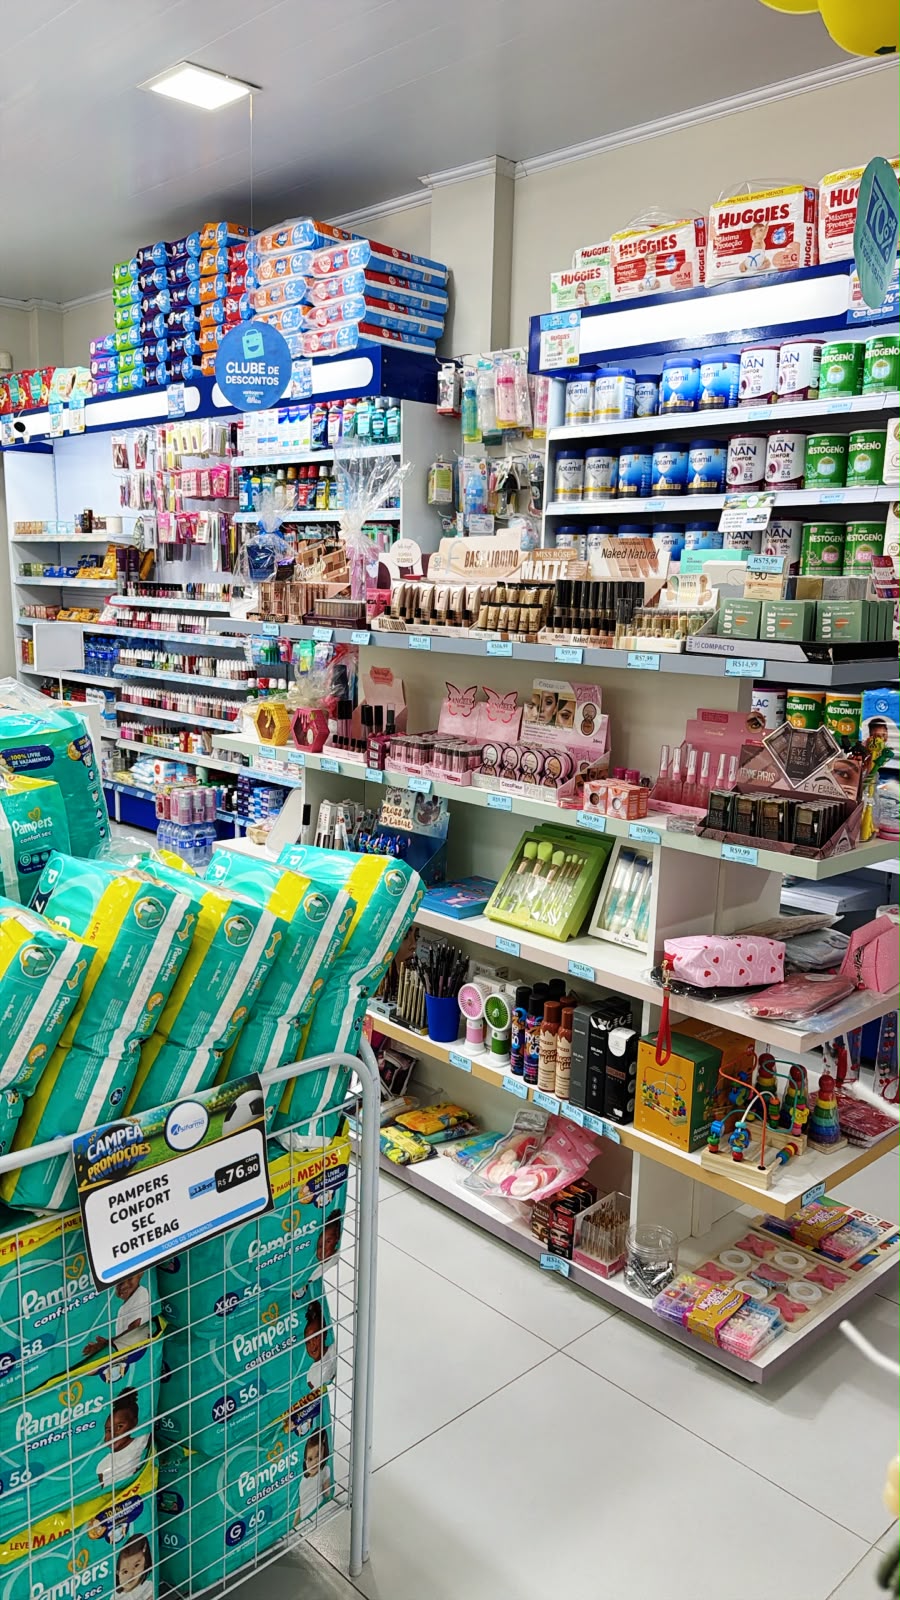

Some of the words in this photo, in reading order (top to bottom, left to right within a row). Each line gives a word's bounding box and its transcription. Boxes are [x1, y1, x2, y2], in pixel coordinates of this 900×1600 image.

[718, 203, 791, 230] HUGGIES
[294, 224, 304, 238] 62
[350, 248, 360, 259] 52
[619, 234, 678, 258] HUGGIES
[804, 226, 812, 266] HUGGIES
[292, 254, 302, 268] 62
[345, 276, 354, 288] 52
[561, 268, 602, 286] HUGGIES
[286, 282, 296, 294] 62
[283, 311, 293, 322] 62
[344, 302, 354, 313] 52
[340, 329, 349, 340] 52
[226, 362, 266, 374] CLUBE
[268, 366, 280, 375] DE
[226, 376, 279, 386] DESCONTOS
[730, 445, 756, 456] NAN
[768, 442, 795, 453] NAN
[654, 457, 677, 466] Aptamil
[765, 528, 792, 538] NAN
[601, 548, 627, 560] Naked
[628, 548, 660, 560] Natural
[521, 560, 568, 580] MATTE
[723, 608, 733, 634] LOVE
[766, 612, 776, 638] LOVE
[822, 612, 832, 638] LOVE
[573, 636, 588, 644] Naked
[701, 643, 735, 652] COMPACTO
[804, 783, 822, 793] EYE
[12, 817, 53, 837] Pampers
[20, 834, 41, 843] confort
[730, 847, 751, 856] R$9,99
[162, 947, 182, 982] Pampers
[248, 964, 268, 997] Pampers
[46, 996, 70, 1033] Pampers
[88, 1142, 152, 1179] PROMOÇÕES
[298, 1153, 338, 1182] MENOS
[217, 1179, 226, 1187] R$
[226, 1163, 259, 1183] 76,90
[108, 1174, 169, 1208] PAMPERS
[110, 1190, 171, 1224] CONFORT
[131, 1213, 156, 1232] SEC
[112, 1219, 180, 1258] FORTEBAG
[162, 1240, 179, 1250] TODOS
[187, 1222, 214, 1238] TAMANHOS
[248, 1220, 318, 1262] Pampers
[255, 1250, 290, 1272] confort
[294, 1240, 311, 1254] sec
[34, 1299, 80, 1328] confort
[233, 1312, 299, 1362] Pampers
[22, 1339, 42, 1359] 58
[245, 1346, 280, 1370] confort
[240, 1384, 258, 1404] 56
[16, 1396, 103, 1441] Pampers
[25, 1429, 72, 1451] confort
[76, 1420, 96, 1433] sec
[9, 1469, 32, 1487] 56
[238, 1451, 298, 1497] Pampers
[246, 1481, 278, 1505] confort
[230, 1525, 242, 1539] G
[248, 1510, 265, 1528] 60
[10, 1540, 29, 1551] LEVE
[164, 1534, 178, 1546] 60
[32, 1561, 109, 1600] Pampers
[84, 1586, 103, 1598] sec
